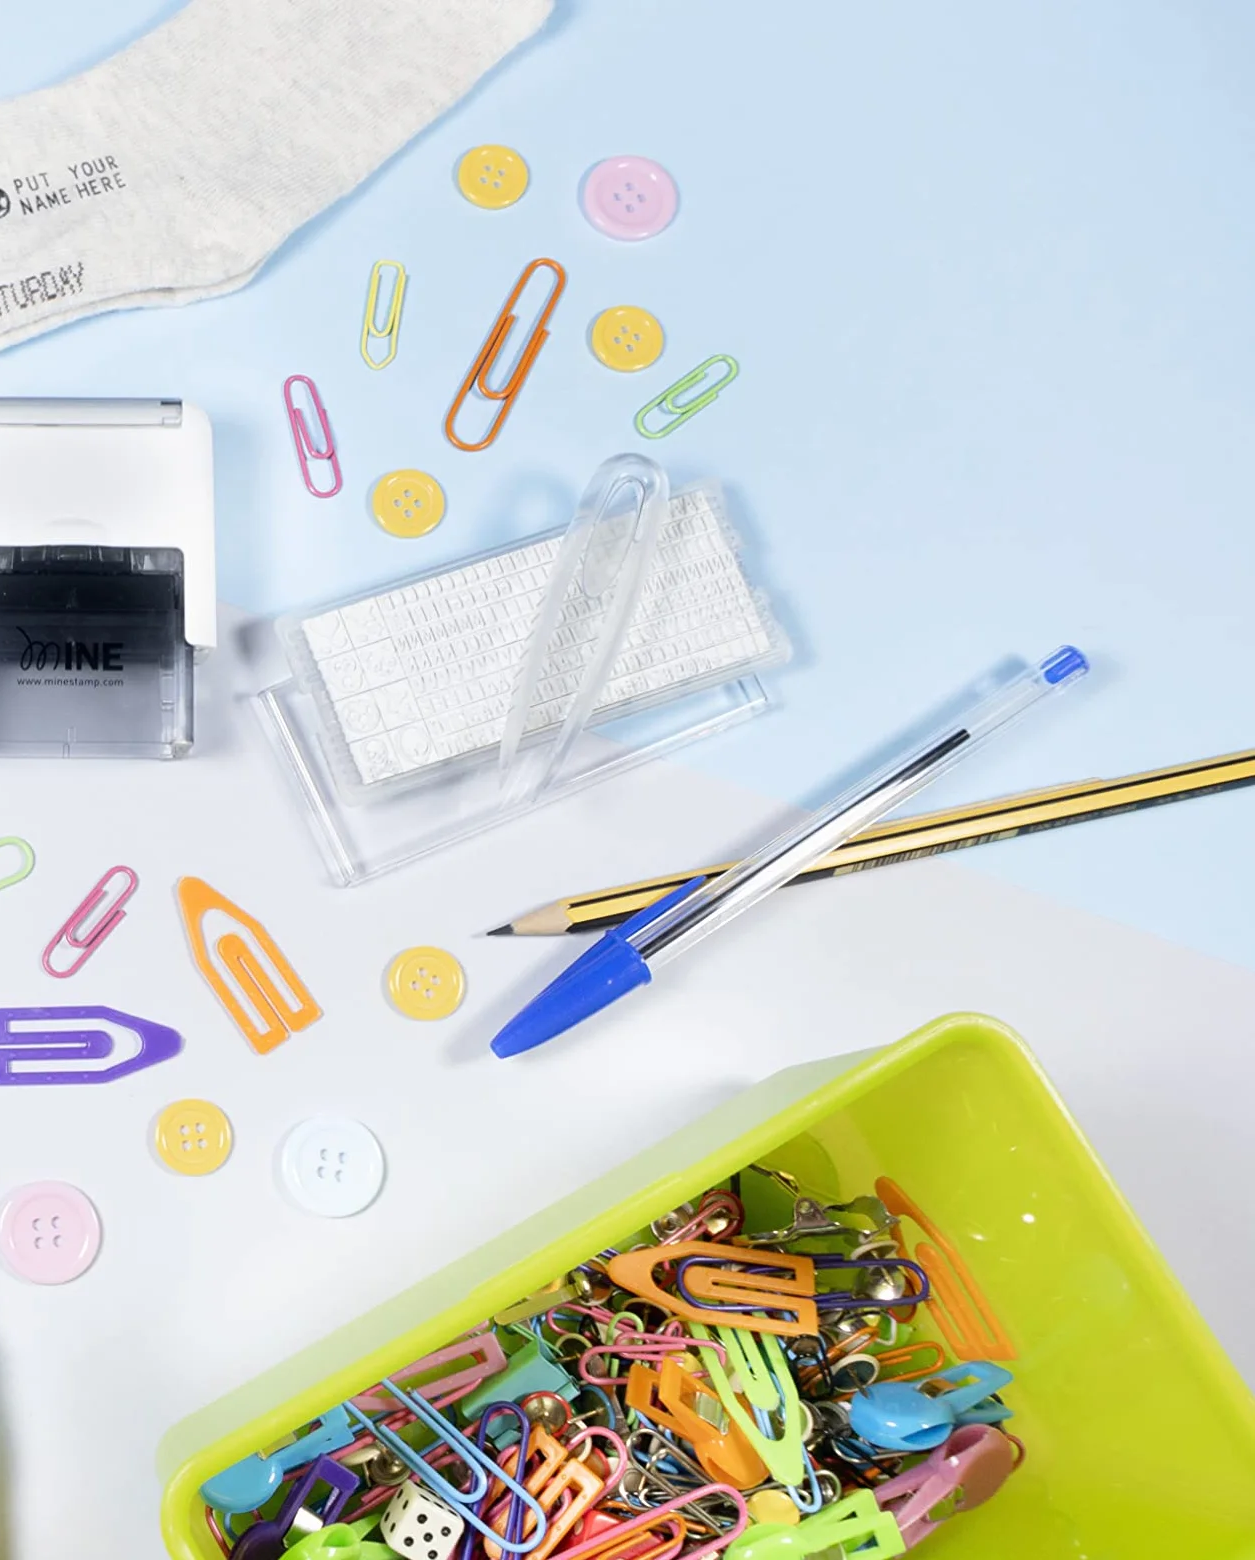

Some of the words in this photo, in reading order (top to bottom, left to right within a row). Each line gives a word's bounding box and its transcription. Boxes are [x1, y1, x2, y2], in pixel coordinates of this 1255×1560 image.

[13, 172, 51, 195] PUT
[67, 155, 120, 180] YOUR
[19, 187, 72, 216] NAME
[75, 172, 127, 199] HERE
[16, 678, 124, 688] www.minestamp.com
